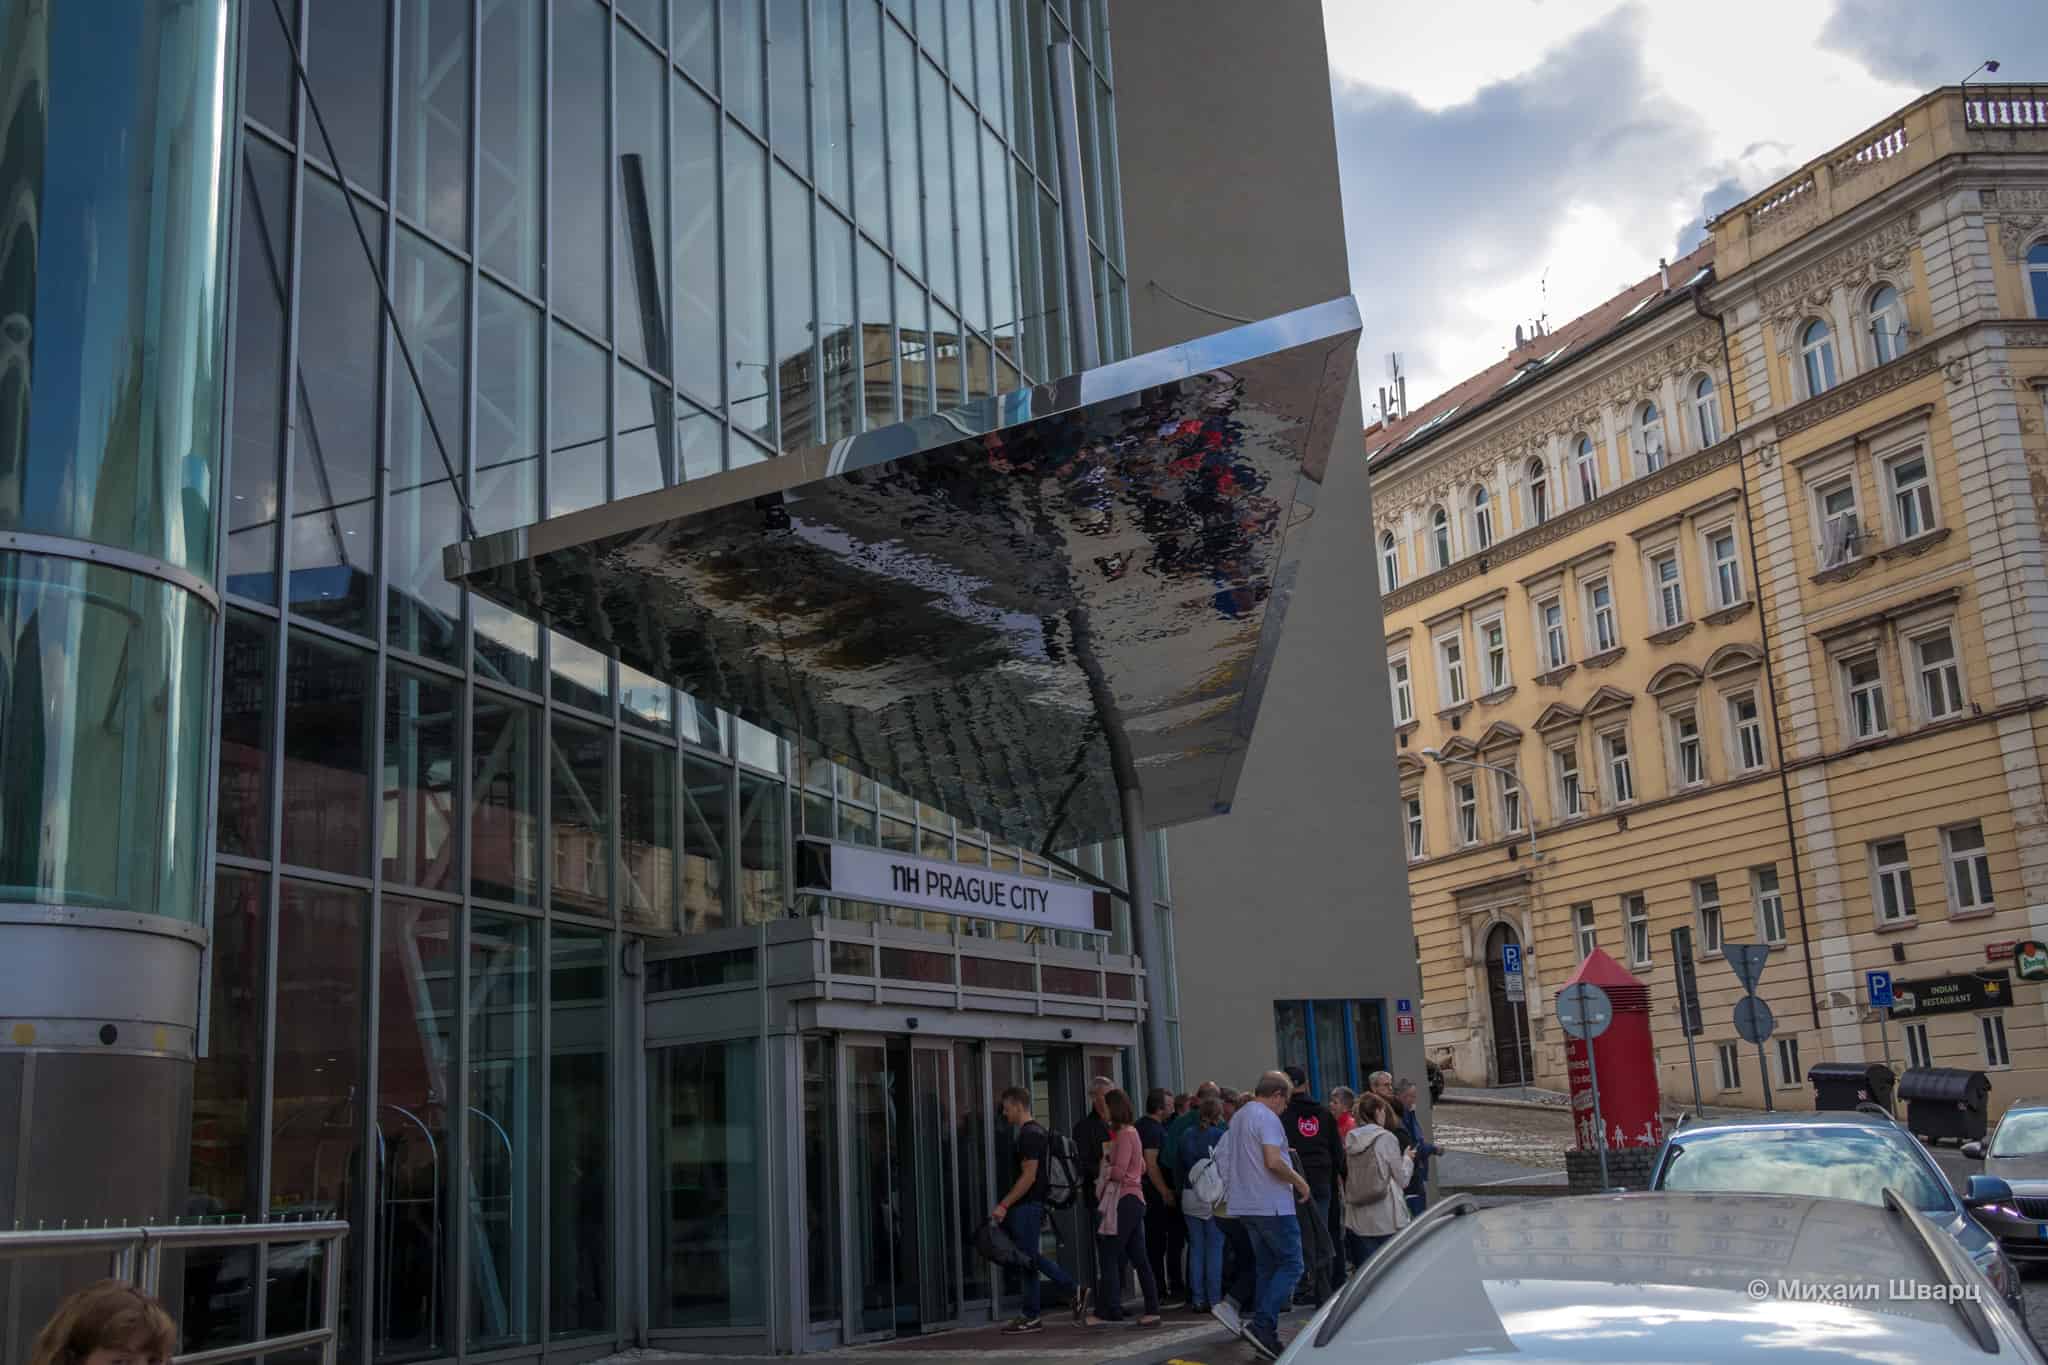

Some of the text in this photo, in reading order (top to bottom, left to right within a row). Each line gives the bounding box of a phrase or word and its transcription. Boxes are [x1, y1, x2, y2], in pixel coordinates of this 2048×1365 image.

[926, 868, 1006, 907] PRAGUE
[1010, 885, 1049, 913] CITY
[1506, 948, 1517, 965] P
[1871, 976, 1886, 996] P
[1930, 984, 1959, 995] INDIAN
[1921, 993, 1972, 1008] RESTAURANT
